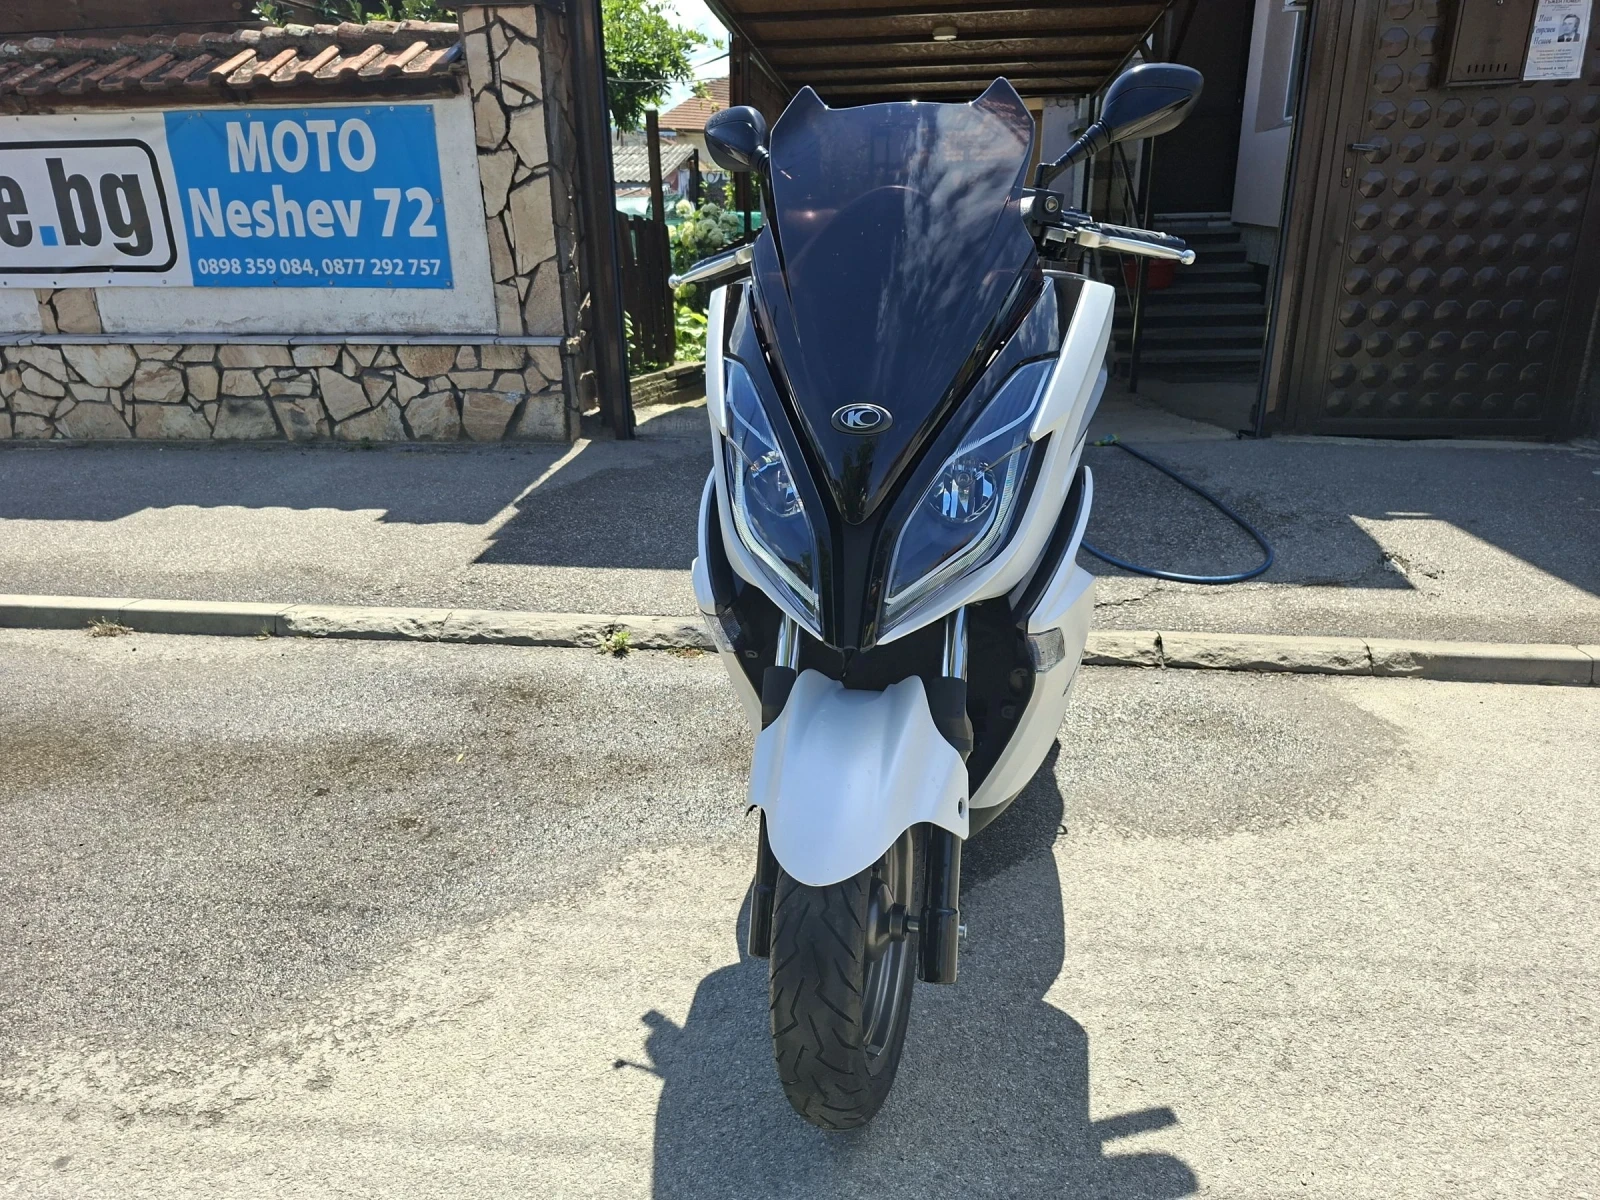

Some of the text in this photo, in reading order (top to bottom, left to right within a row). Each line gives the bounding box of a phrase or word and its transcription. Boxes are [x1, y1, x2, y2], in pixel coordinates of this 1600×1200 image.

[226, 118, 376, 173] MOTO
[188, 184, 437, 238] Neshev 72
[198, 258, 441, 277] 0898 359 084, 0877 292 757
